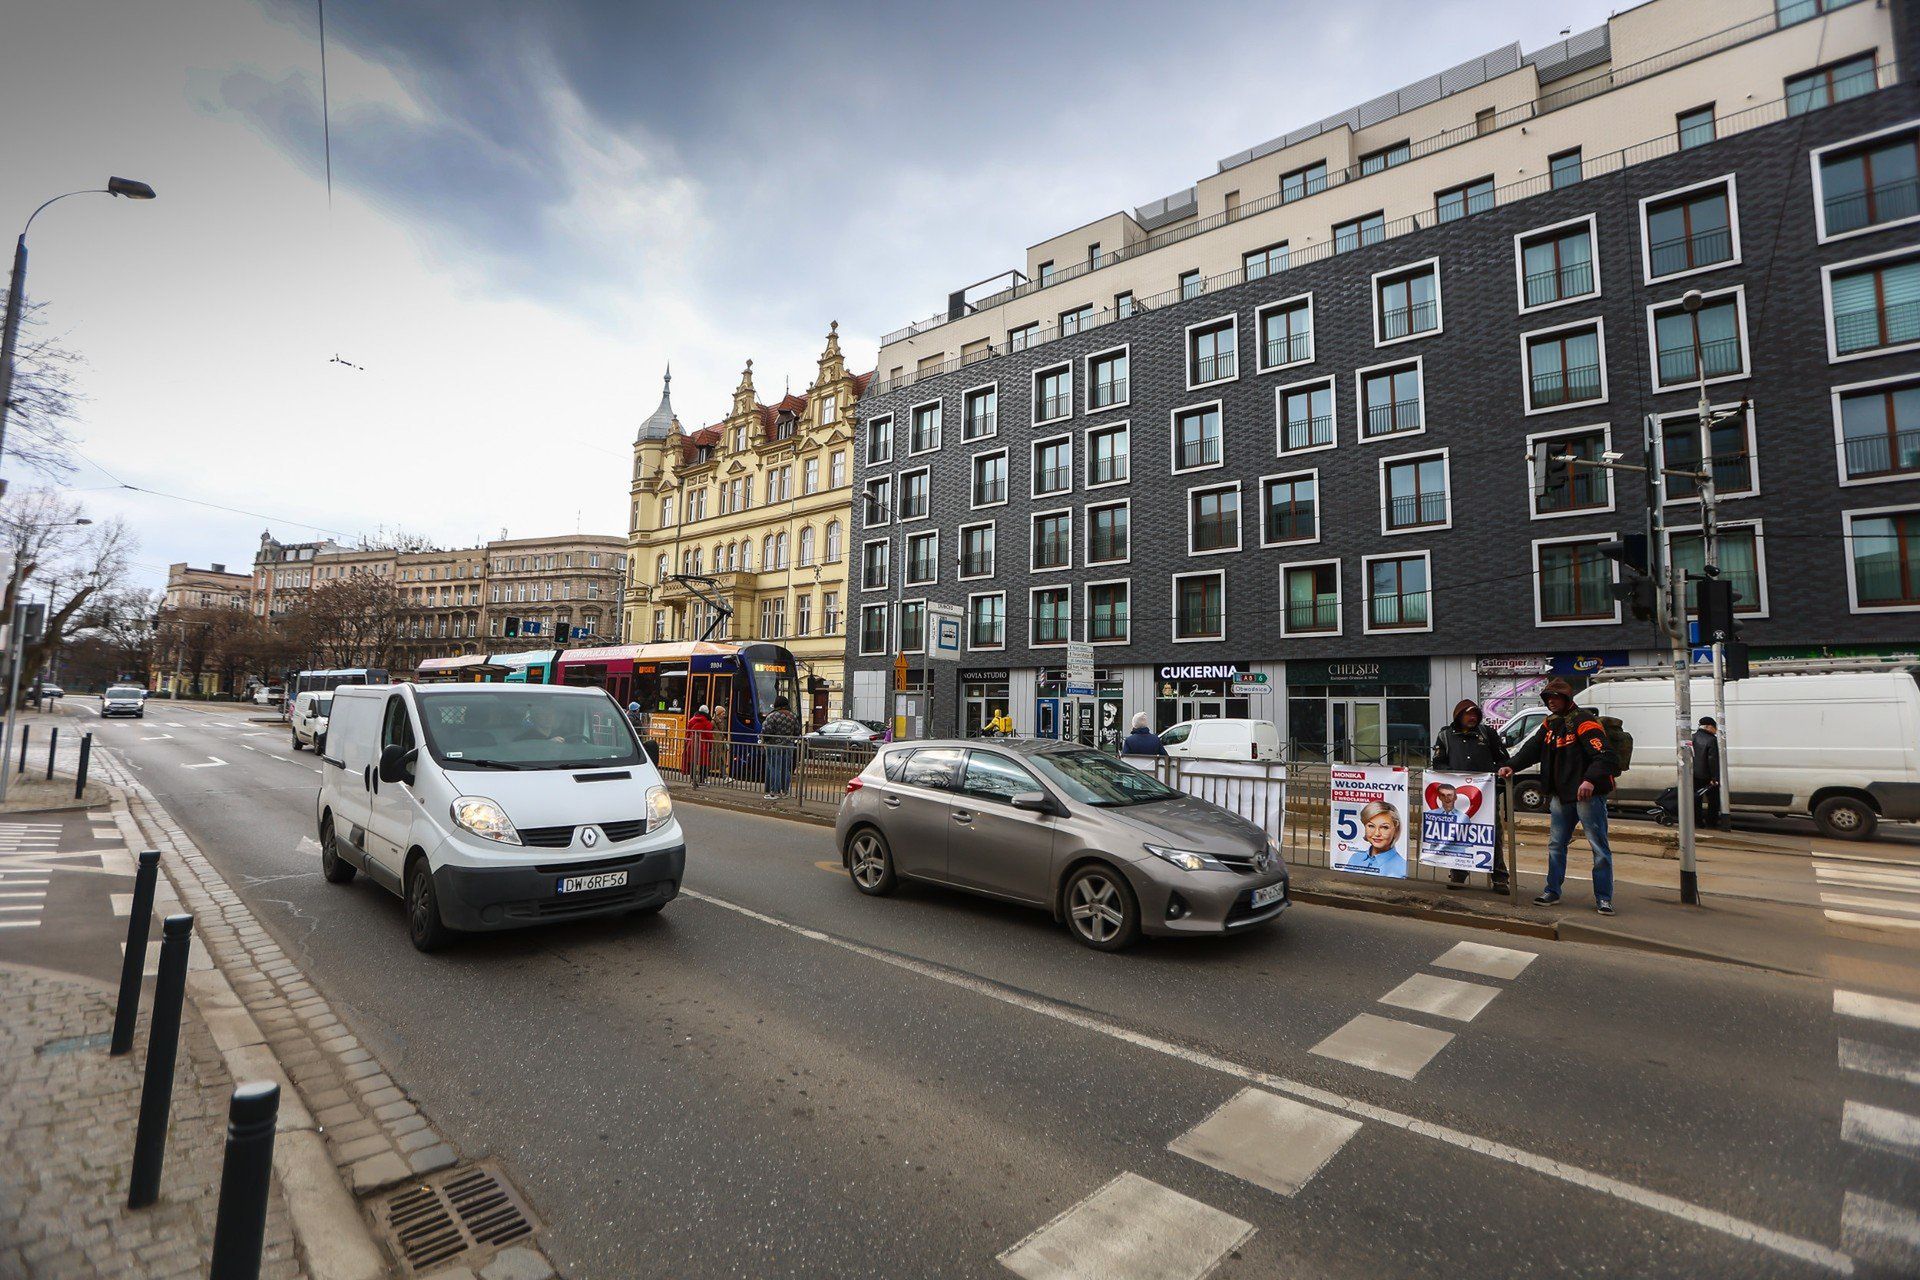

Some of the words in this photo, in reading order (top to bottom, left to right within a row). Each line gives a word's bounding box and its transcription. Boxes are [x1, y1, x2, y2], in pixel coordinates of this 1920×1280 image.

[1328, 664, 1379, 676] CHEESER
[1482, 659, 1508, 667] Salon
[1509, 660, 1527, 668] gier
[983, 671, 1008, 679] STUDIO
[1161, 665, 1238, 679] CUKIERNIA
[1335, 781, 1405, 792] WŁODARCZYK
[1337, 809, 1357, 840] 5
[1425, 814, 1454, 823] Krzysztof
[1425, 821, 1493, 844] ZALEWSKI
[1476, 851, 1492, 868] 2
[566, 878, 583, 891] DW
[587, 873, 624, 888] 6RF56
